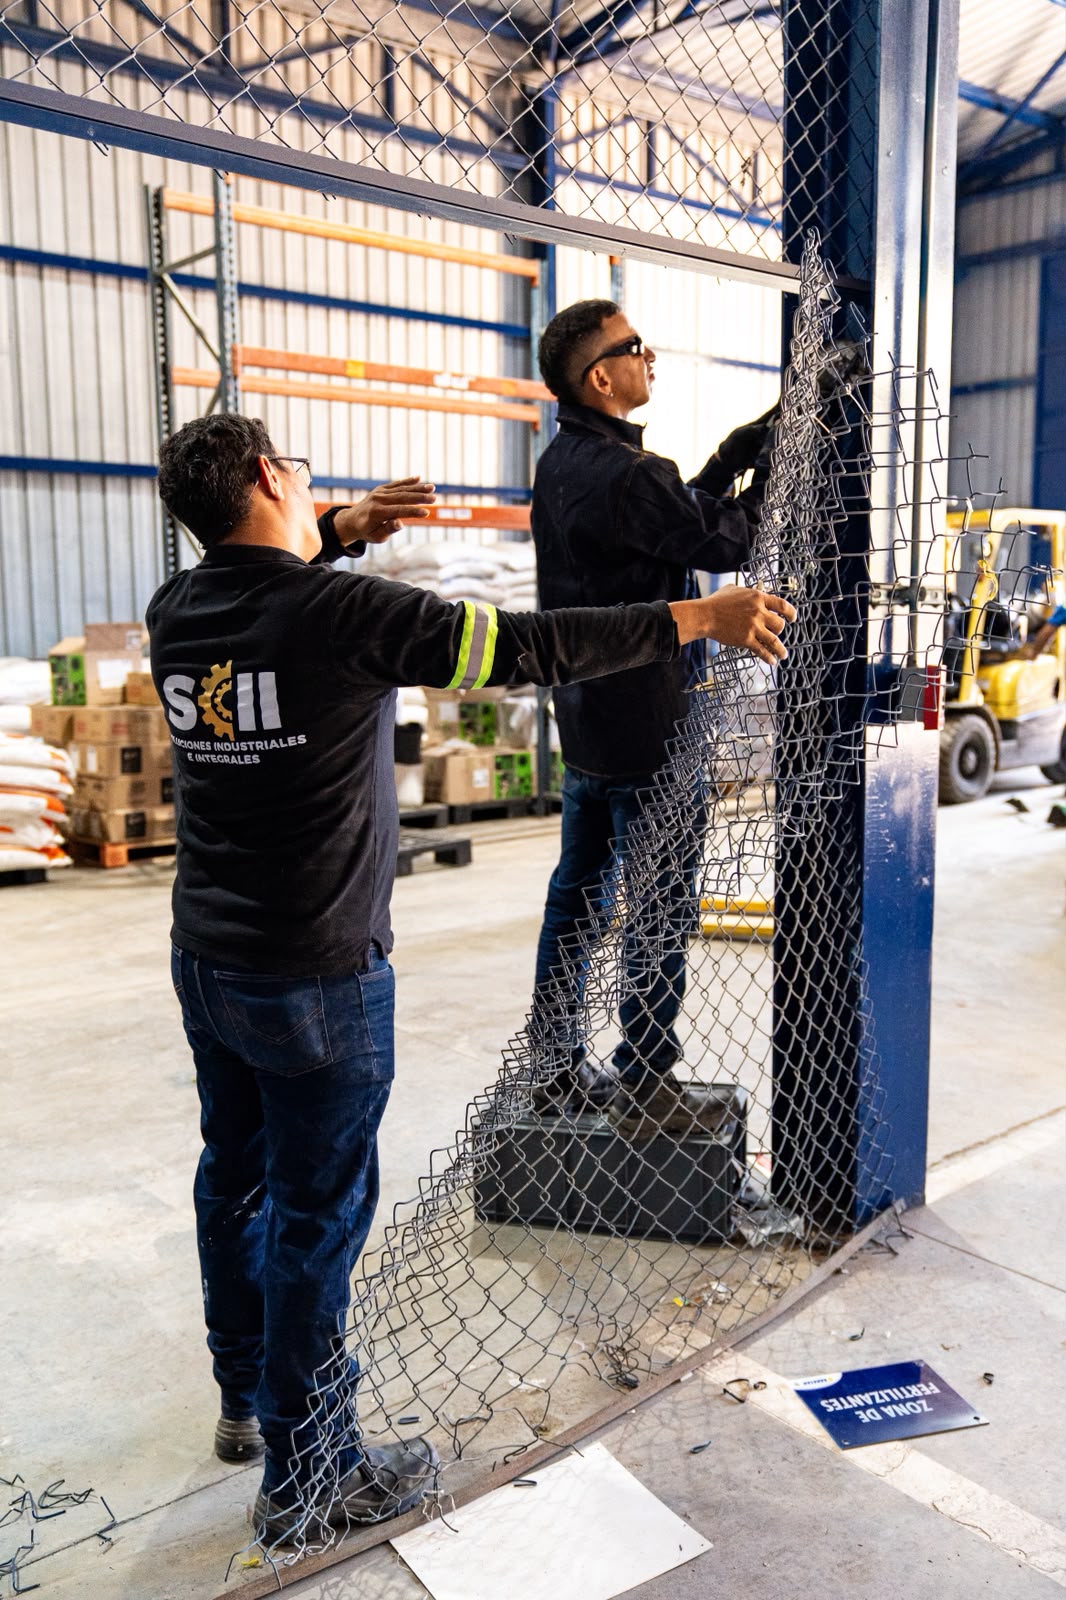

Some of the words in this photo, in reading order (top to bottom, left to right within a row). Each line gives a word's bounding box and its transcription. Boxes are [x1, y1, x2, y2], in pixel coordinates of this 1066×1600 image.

[213, 734, 307, 752] INDUSTRIALES
[187, 752, 194, 762] E
[195, 753, 261, 765] INTEGRALES
[820, 1382, 941, 1412] FERTILIZANTES
[855, 1408, 880, 1423] DE
[882, 1399, 933, 1418] ZONA
